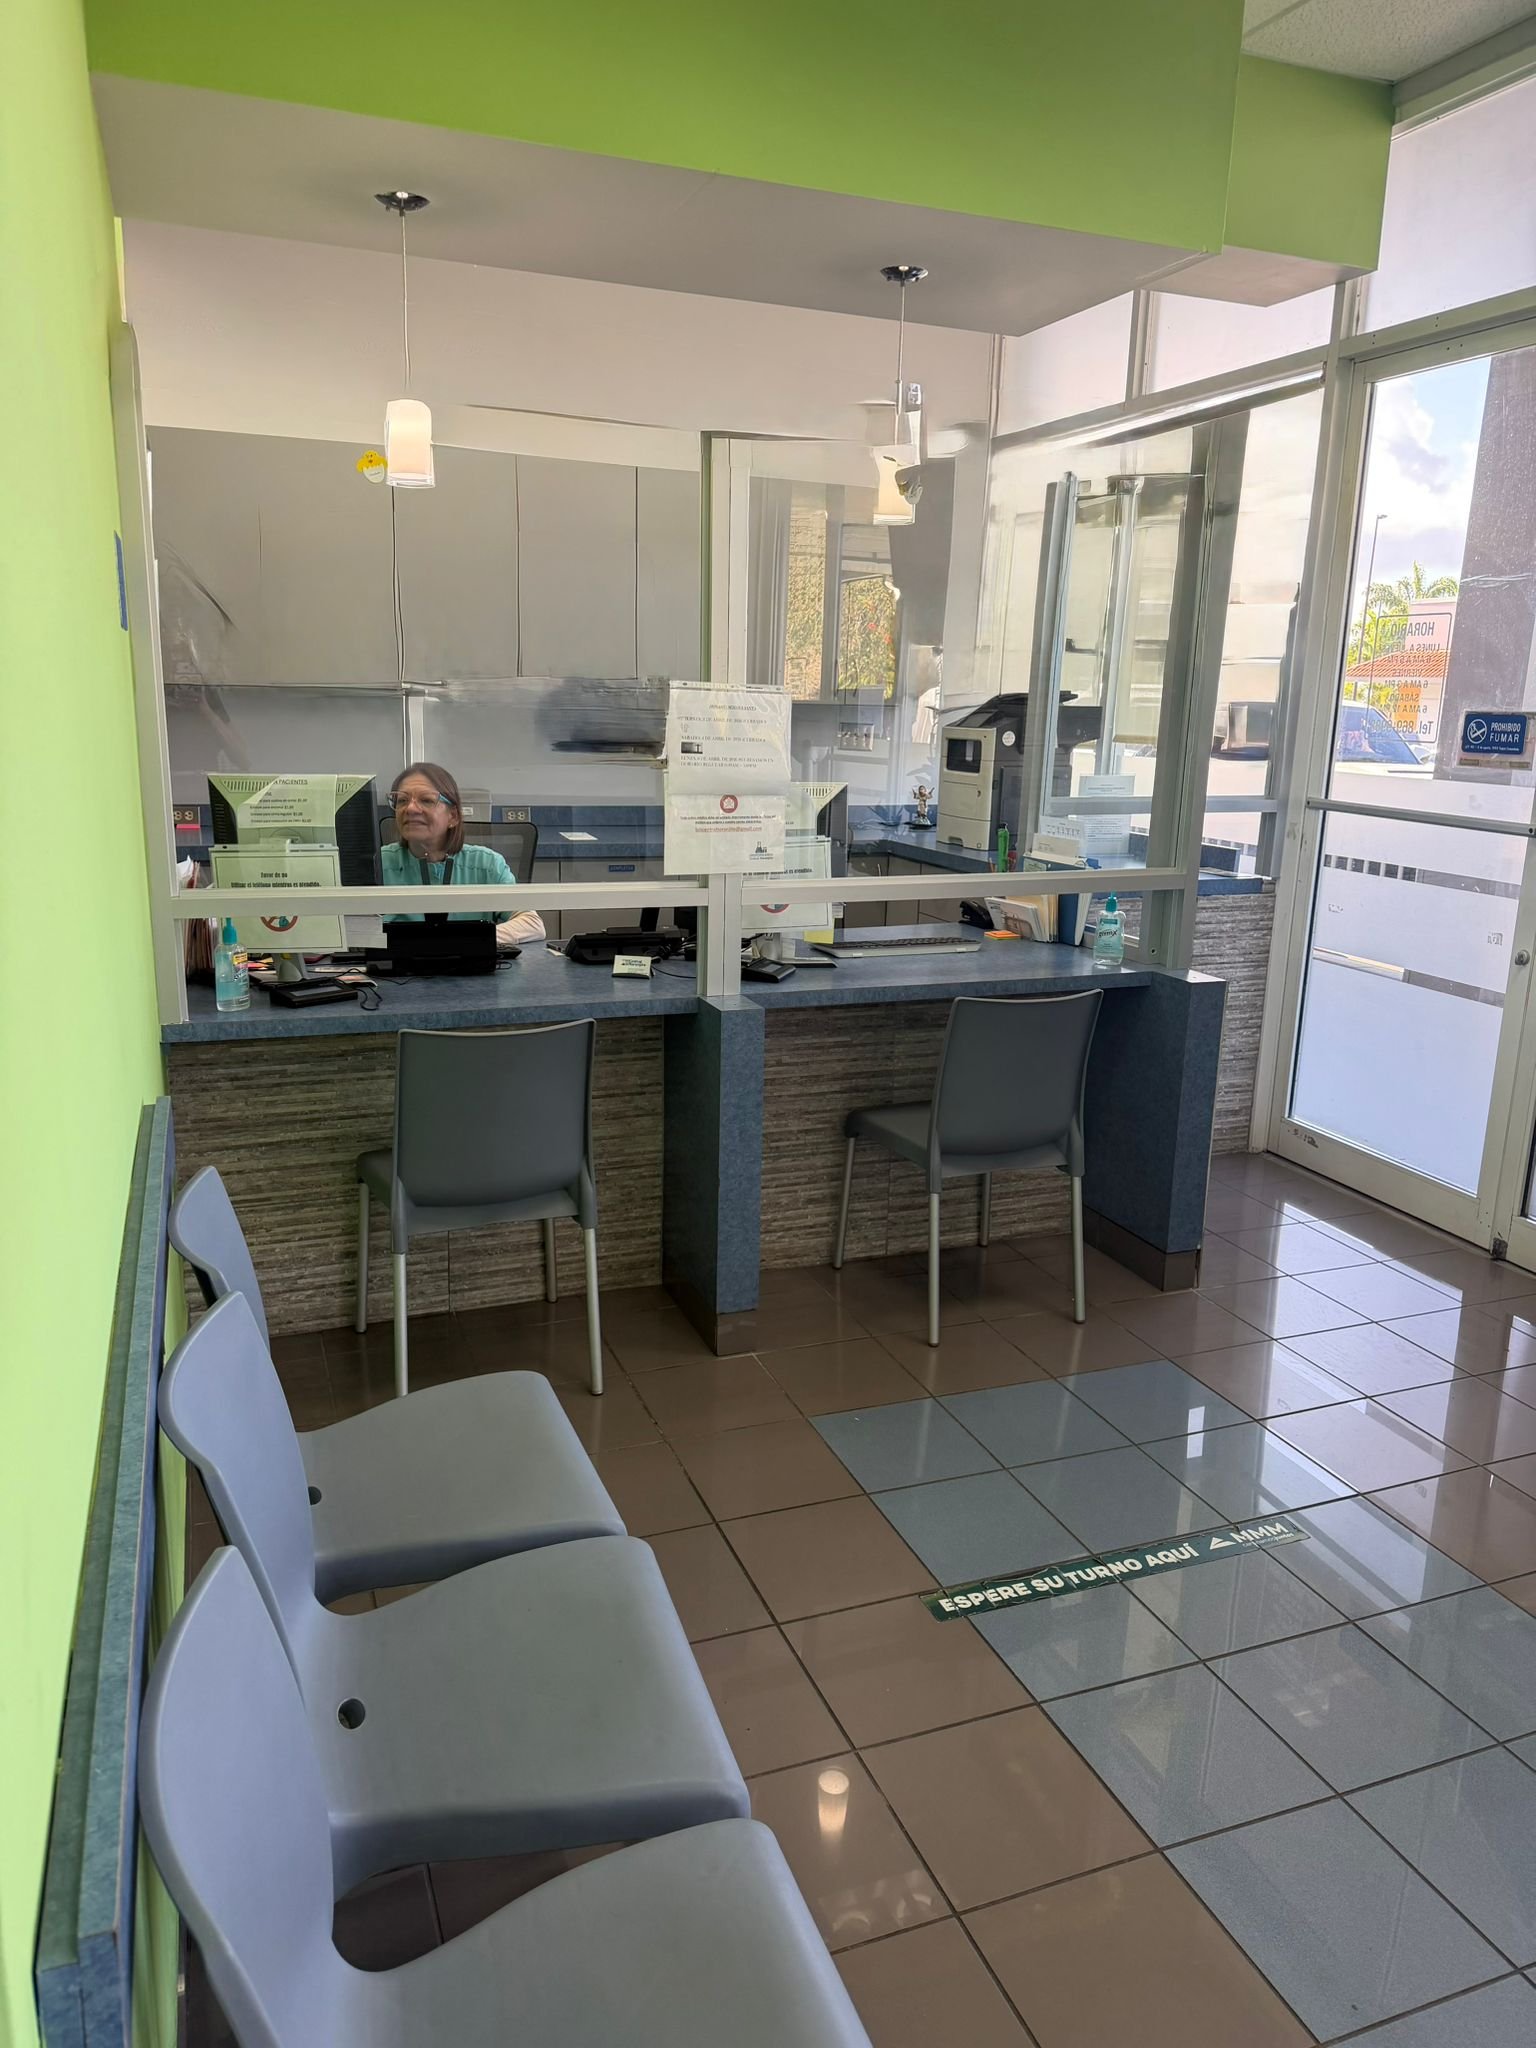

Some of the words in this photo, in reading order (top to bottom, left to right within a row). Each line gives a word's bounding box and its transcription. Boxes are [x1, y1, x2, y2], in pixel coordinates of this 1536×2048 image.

[1490, 722, 1521, 732] PROHIBIDO
[1489, 732, 1520, 743] FUMAR
[937, 1581, 1032, 1612] ESPERE
[1031, 1575, 1065, 1593] SU
[1063, 1558, 1142, 1585] TURNO
[1144, 1542, 1200, 1568] AQUÍ
[1229, 1522, 1289, 1543] MMM
